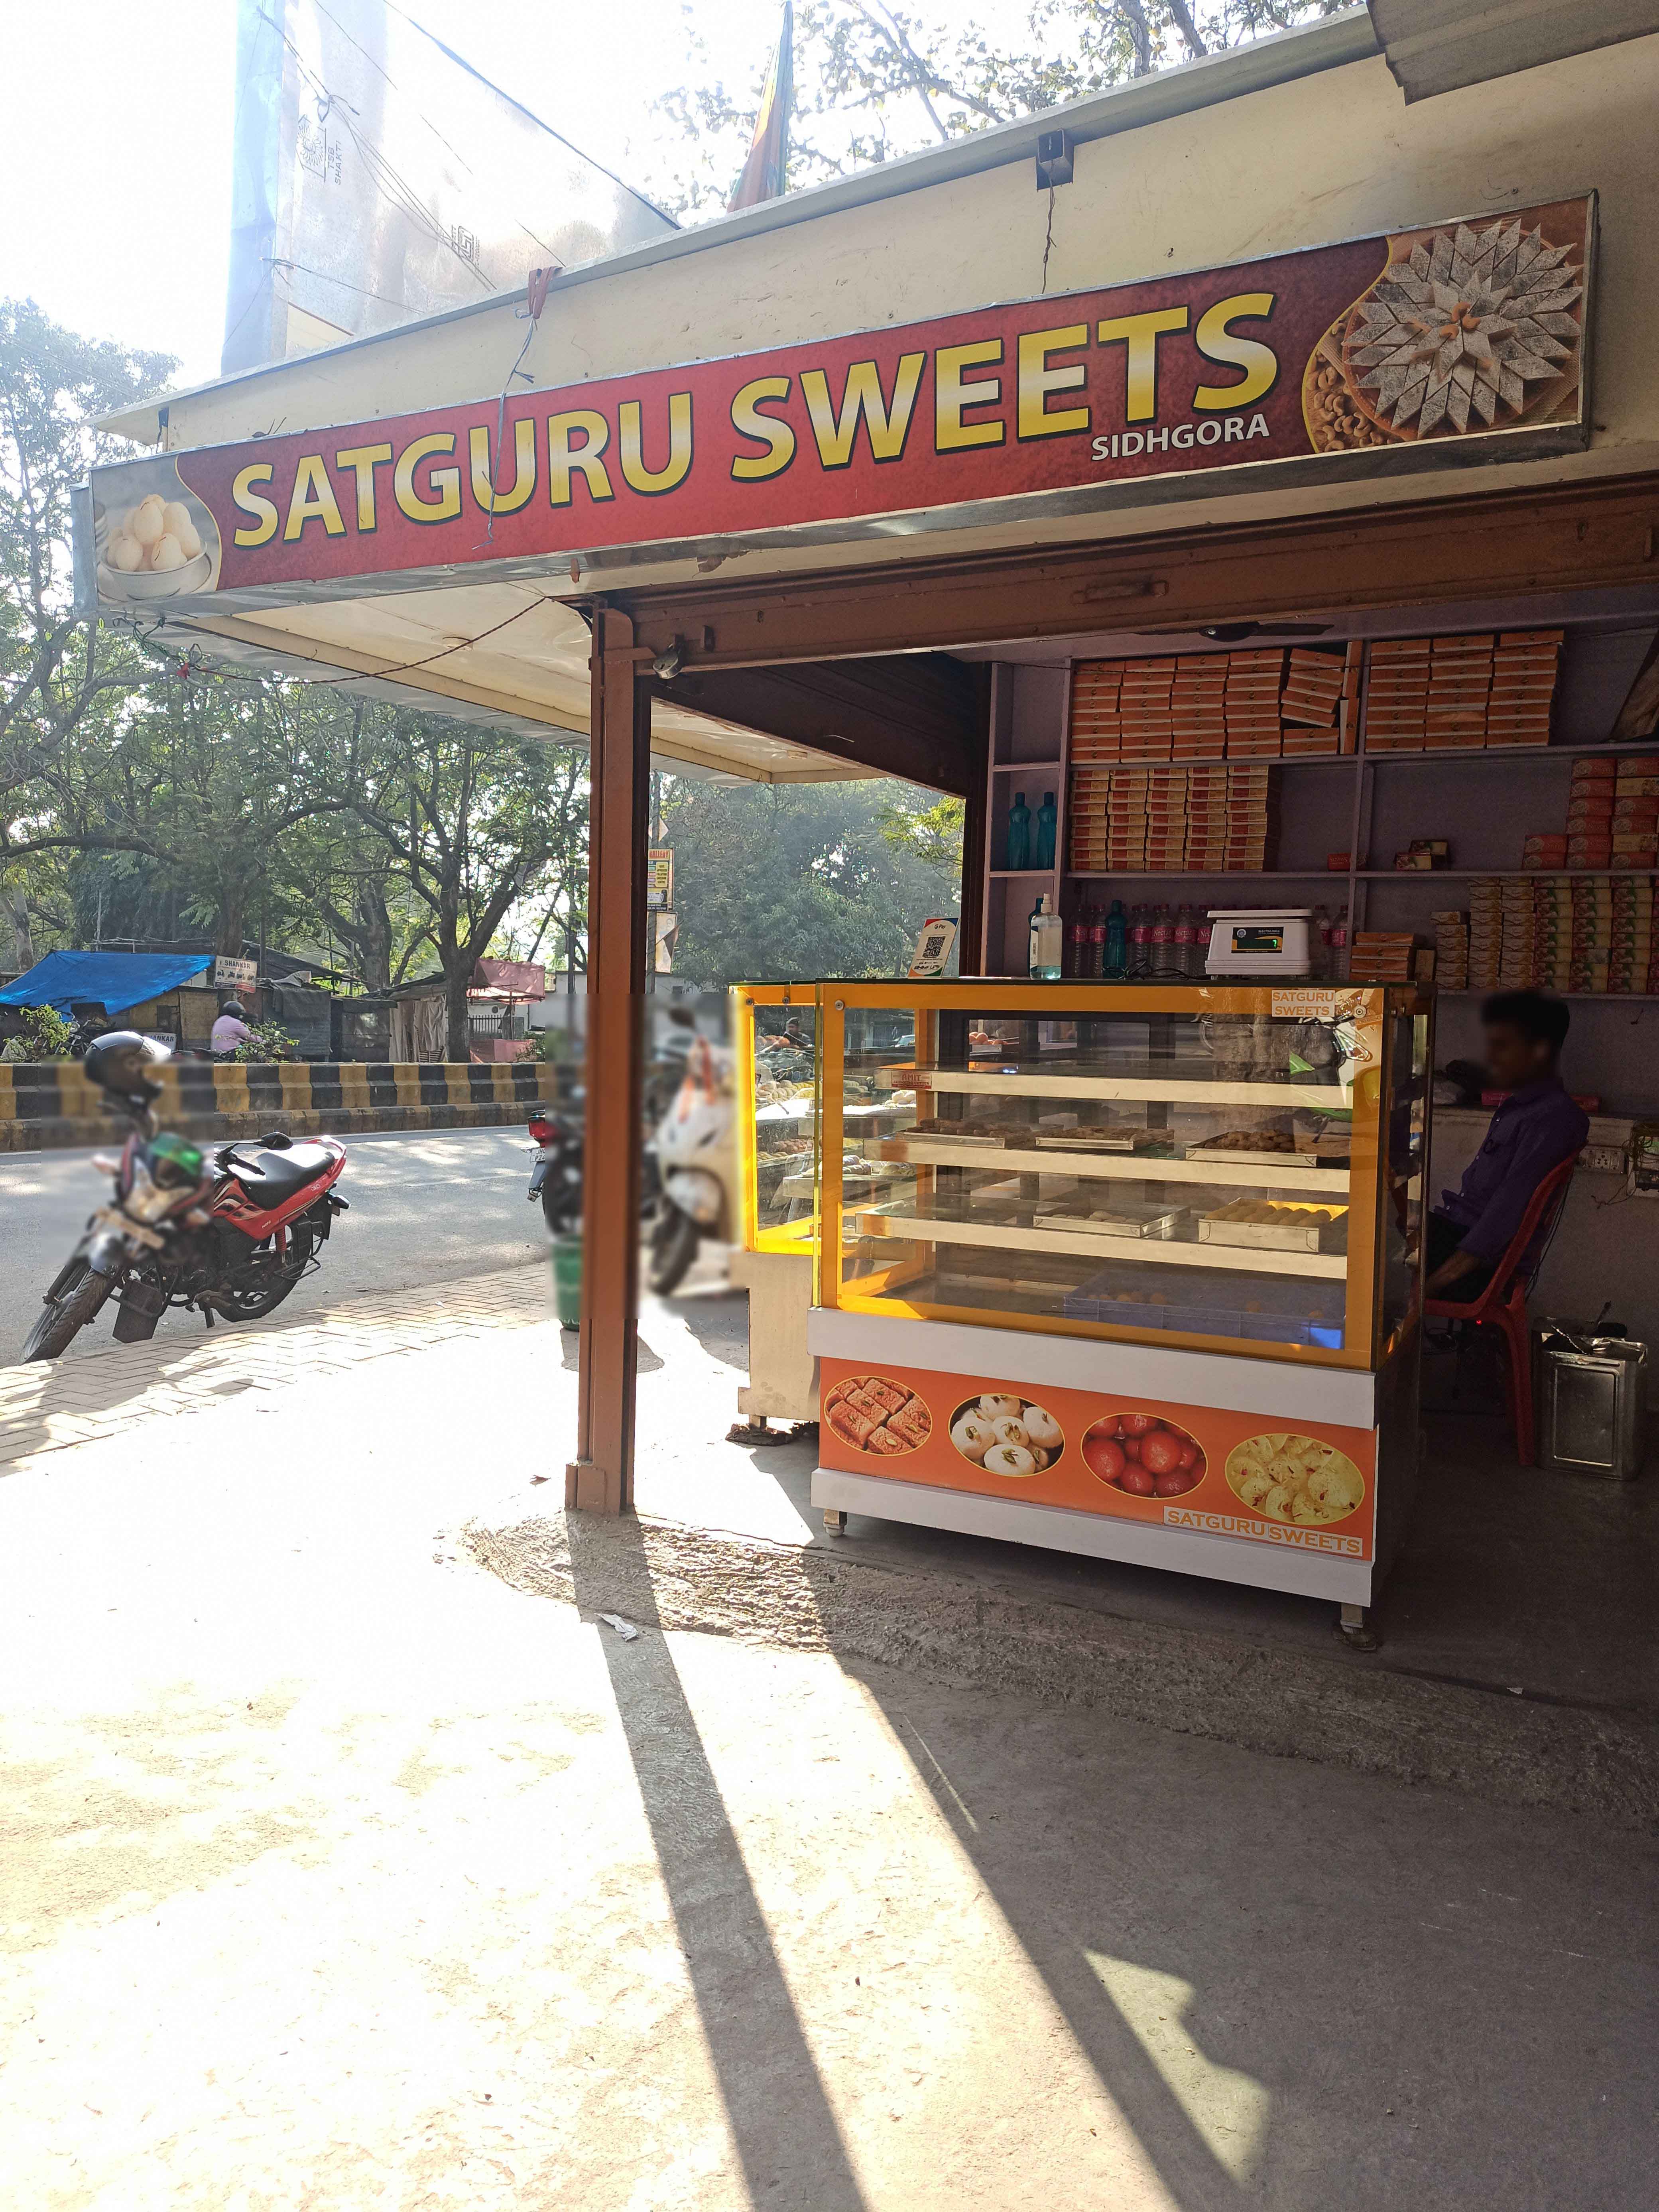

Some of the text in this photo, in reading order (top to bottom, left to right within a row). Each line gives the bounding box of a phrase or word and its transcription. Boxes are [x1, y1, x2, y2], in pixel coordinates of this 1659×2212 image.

[232, 293, 1278, 550] SATGURU SWEETS
[1091, 413, 1270, 462] SIDHGORA
[224, 960, 250, 969] SHANKAR
[1273, 992, 1334, 1002] SATGURU
[1275, 1006, 1330, 1015] SWEETS
[1167, 1511, 1360, 1553] SATGURU SWEETS
